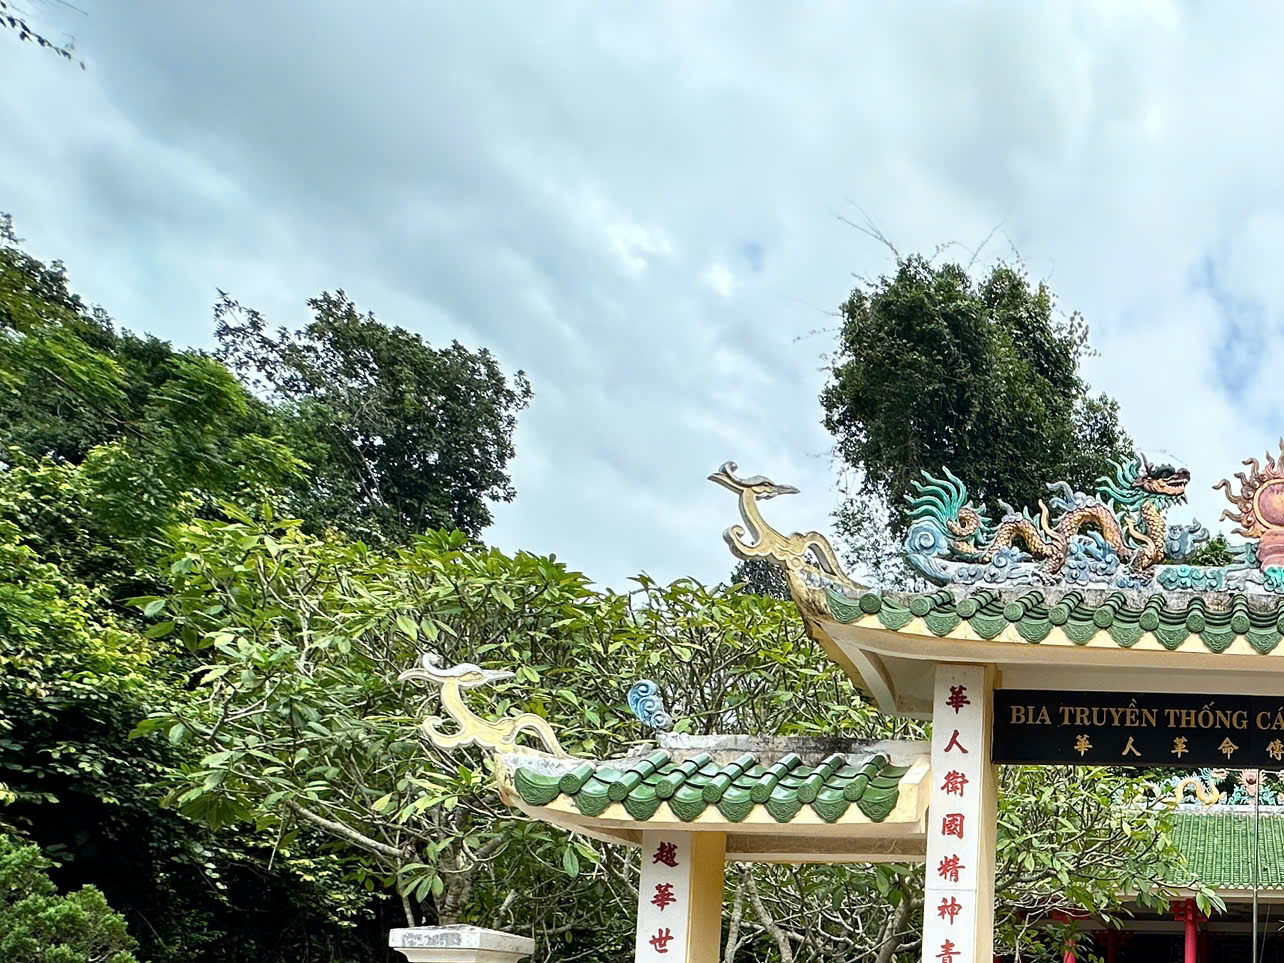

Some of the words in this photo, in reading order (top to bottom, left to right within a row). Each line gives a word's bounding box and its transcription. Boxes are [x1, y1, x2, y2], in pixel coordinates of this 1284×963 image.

[1010, 705, 1052, 725] BIA
[1060, 699, 1158, 728] TRUYỀN
[1165, 701, 1249, 729] THỐNG
